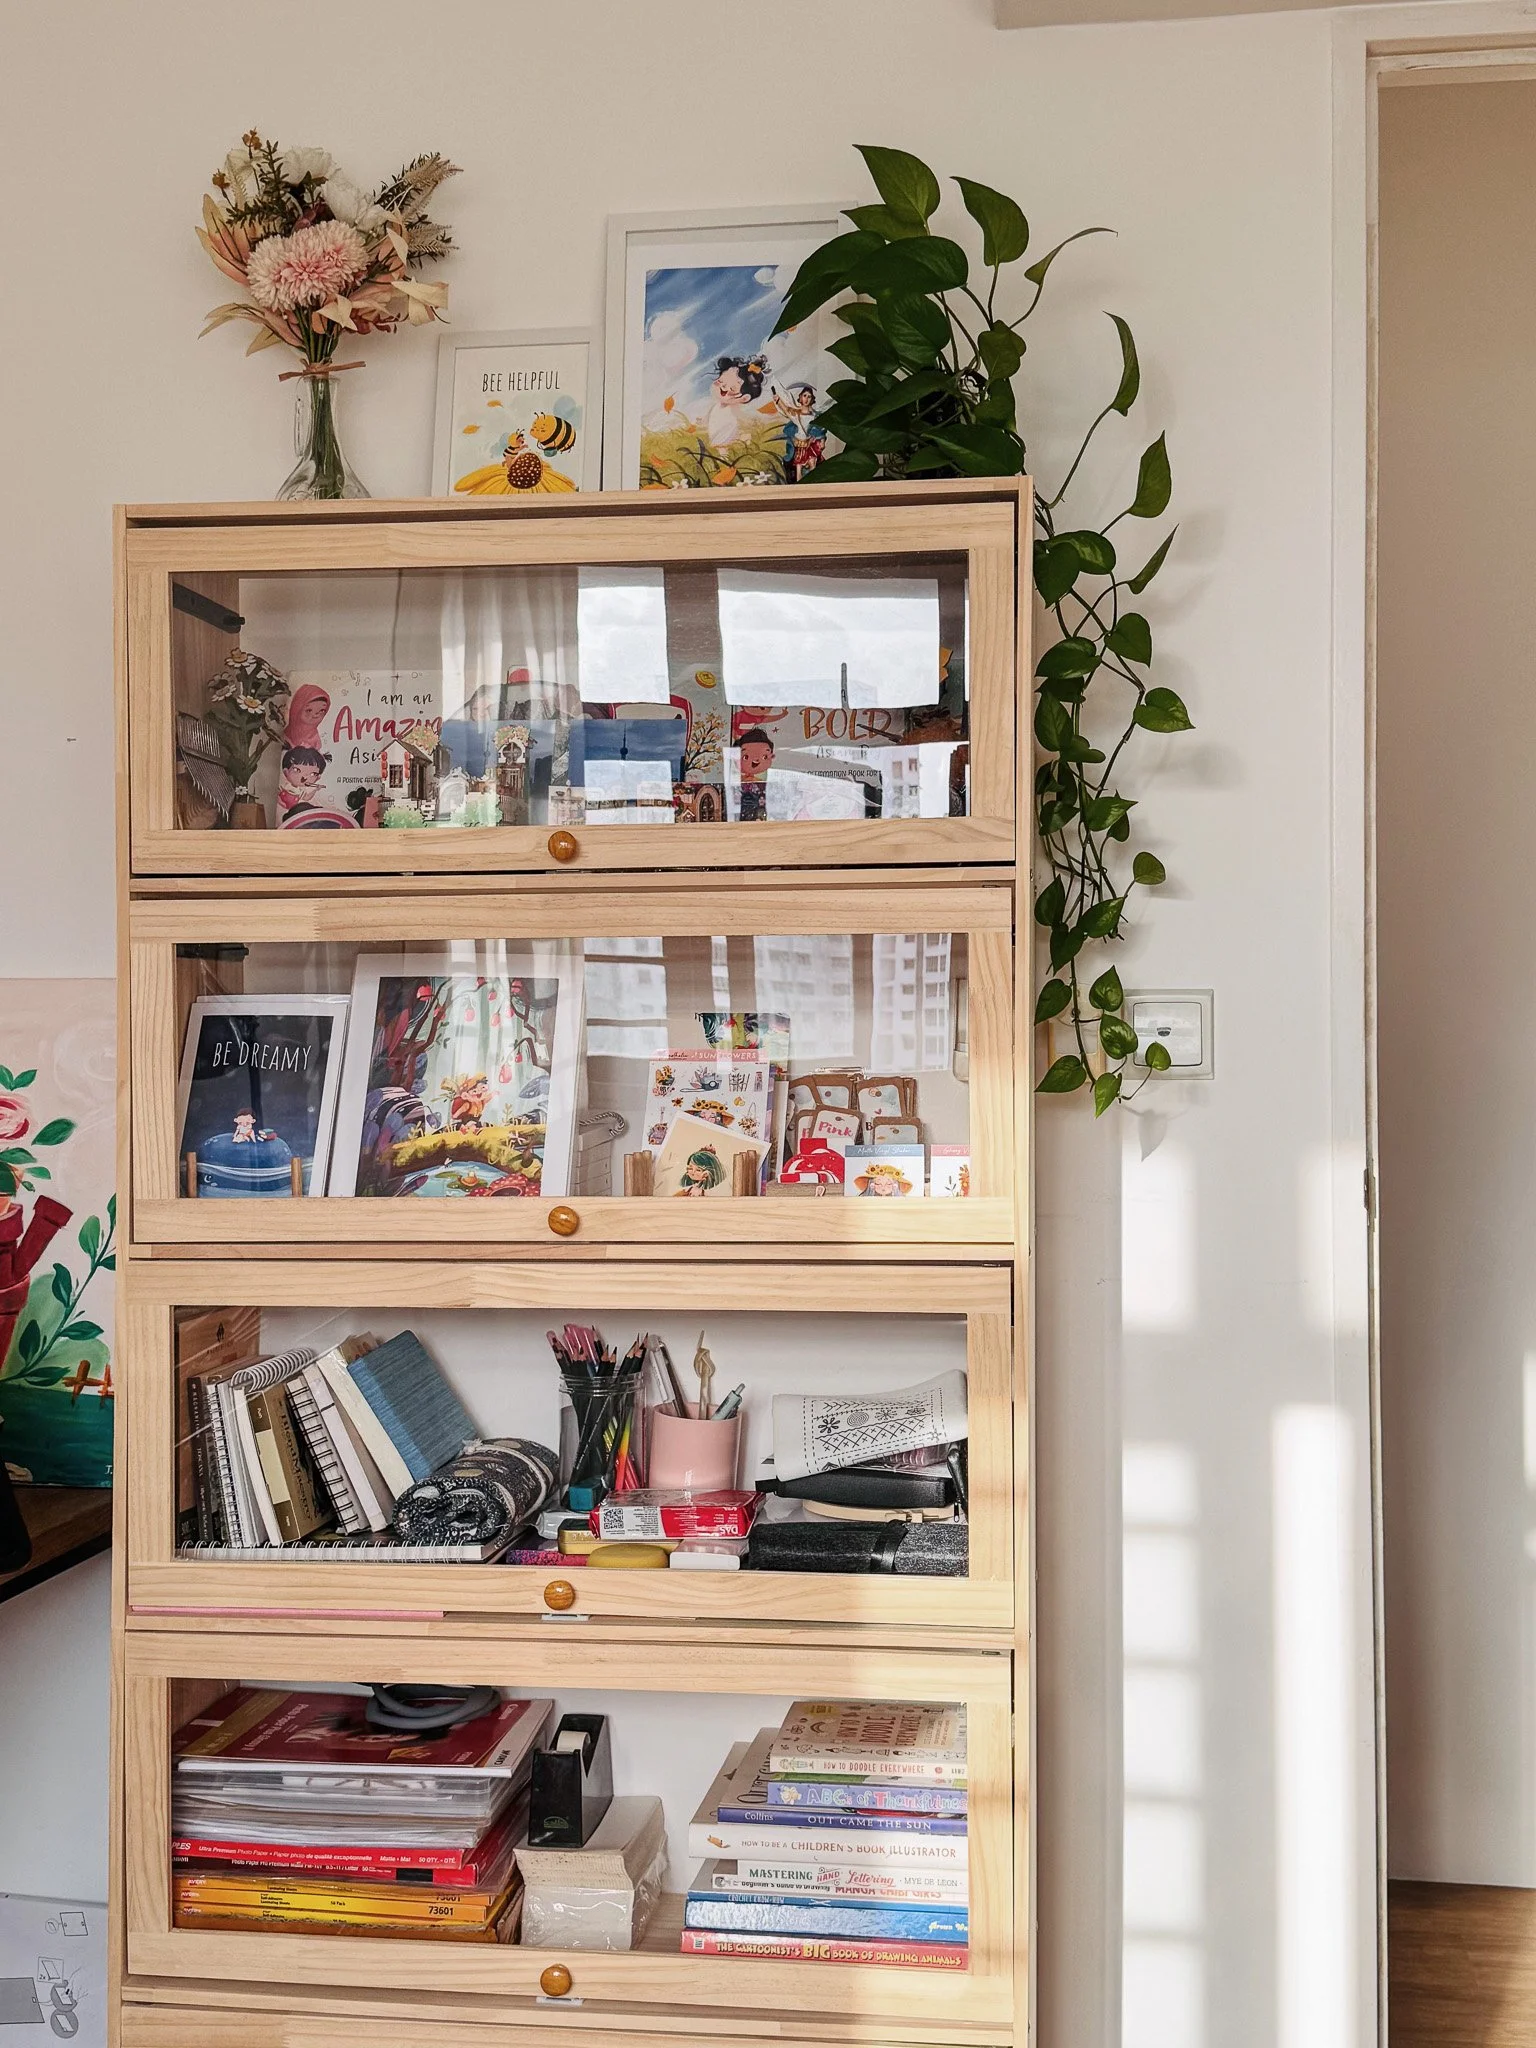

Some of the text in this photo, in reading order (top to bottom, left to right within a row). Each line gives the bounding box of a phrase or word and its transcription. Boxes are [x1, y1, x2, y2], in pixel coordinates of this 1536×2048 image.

[482, 370, 560, 393] BEE HELPFUL
[367, 689, 433, 706] I am an
[799, 707, 892, 740] BOLD
[847, 769, 865, 777] BOOK
[212, 1041, 312, 1073] BE DREAMY
[818, 1121, 853, 1137] Pink
[823, 1762, 836, 1770] HOW
[850, 1762, 877, 1773] DOODLE
[880, 1763, 925, 1774] EVERYWHERE
[856, 1791, 873, 1807] of
[744, 1811, 931, 1830] Collins OUT CAME THE SUN
[856, 1844, 886, 1854] BOOK
[888, 1844, 956, 1858] ILLUSTRATOR
[749, 1868, 958, 1888] MASTERING HAND Lettering MYE DE LEON
[428, 1905, 454, 1916] 73601
[716, 1942, 962, 1966] THE CARTOONIST'S BIG BOOK OF DRAWING ANIMALS
